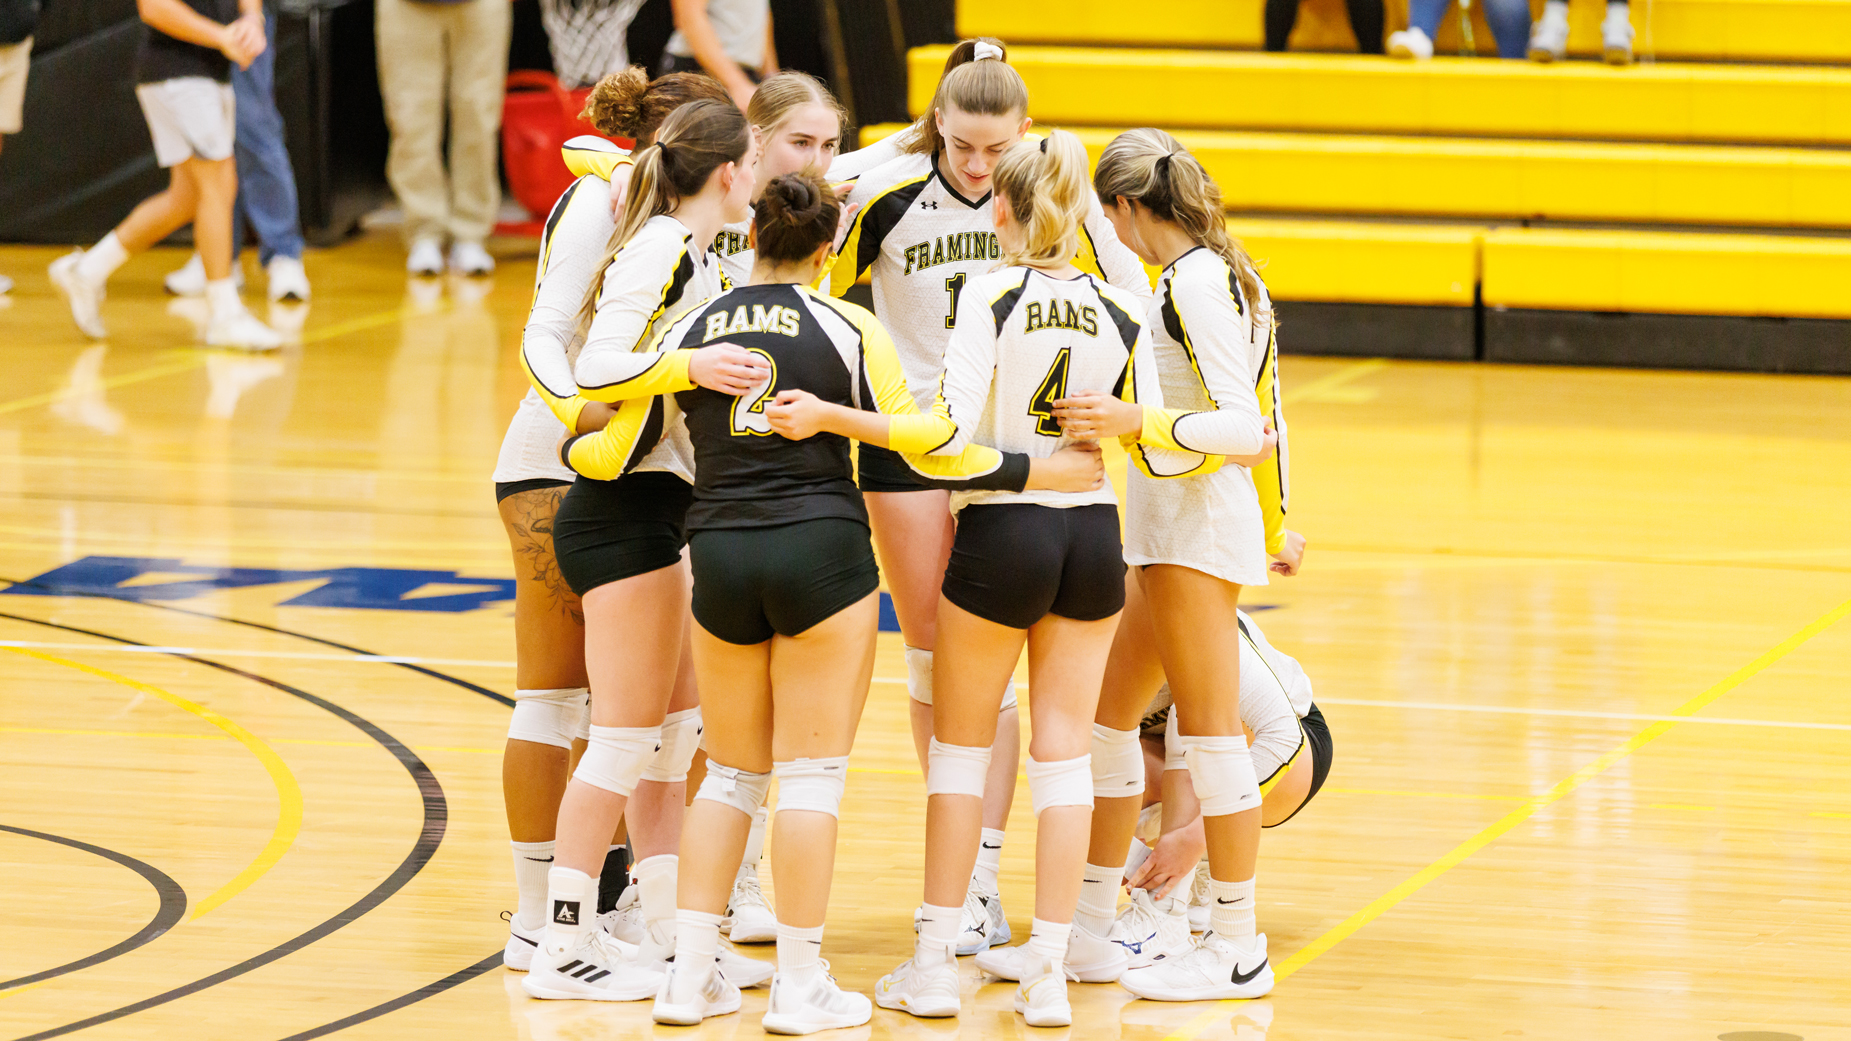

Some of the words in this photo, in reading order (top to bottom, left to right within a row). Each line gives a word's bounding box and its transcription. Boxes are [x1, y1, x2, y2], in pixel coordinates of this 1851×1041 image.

[904, 231, 1005, 276] FRAMING
[702, 304, 801, 343] RAMS
[1024, 298, 1099, 338] RAMS
[729, 347, 778, 437] 2
[1027, 346, 1071, 438] 4
